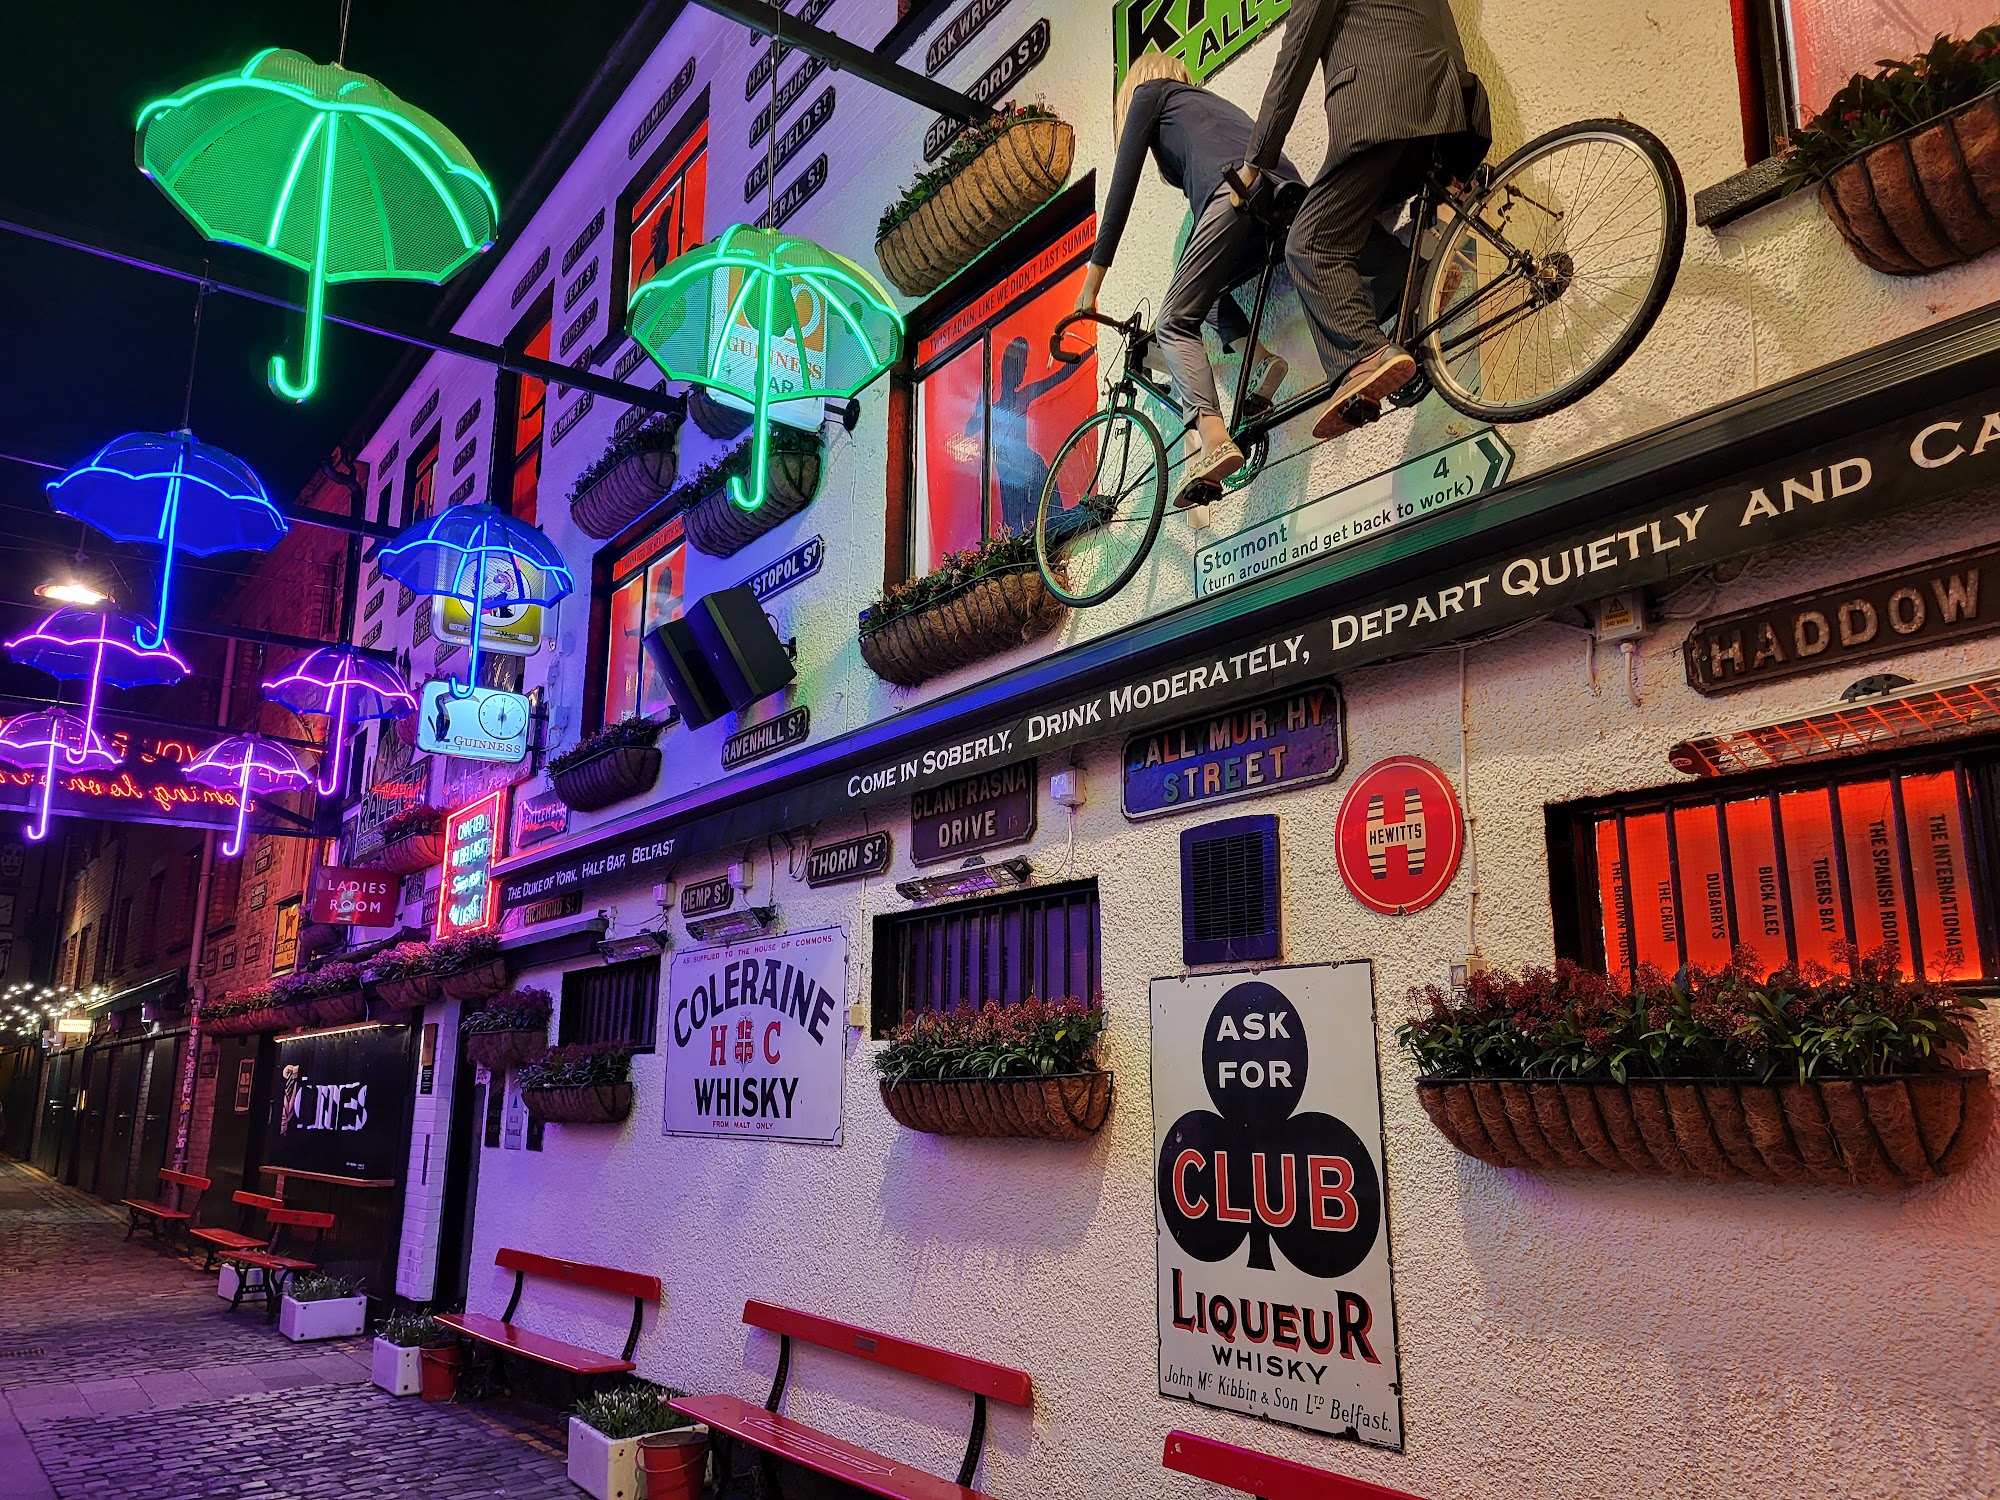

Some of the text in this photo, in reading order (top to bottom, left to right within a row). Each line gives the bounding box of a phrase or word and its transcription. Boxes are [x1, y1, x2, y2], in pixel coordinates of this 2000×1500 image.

[926, 56, 1013, 154] BRAFORD
[930, 220, 1096, 353] TWIST AGAIN, LIKE WE DIDN'T LAST SUMME
[728, 335, 822, 380] GUINESS
[1433, 457, 1450, 480] 4
[1202, 475, 1474, 596] (turn around and get back to work)
[1202, 522, 1288, 575] Stormont
[749, 559, 800, 596] STOPOL
[847, 766, 897, 798] COME
[900, 759, 919, 783] IN
[922, 729, 1013, 774] SOBERLY,
[1027, 699, 1102, 743] DRINK
[1109, 633, 1310, 718] MODERATELY,
[1330, 574, 1490, 652] DEPART
[1500, 506, 1710, 598] QUIETLY
[1738, 456, 1873, 529] AND
[1606, 610, 1629, 620] DANGER
[1709, 568, 1980, 679] HADDOW
[454, 735, 521, 754] GUINNESS
[722, 722, 784, 763] RAVENHILL
[1130, 690, 1325, 772] BALLYMURPHY
[913, 763, 1027, 821] CLANTRASNA
[1163, 745, 1287, 803] STREET
[938, 810, 996, 848] DRIVE
[1369, 823, 1422, 846] HEWITTS
[1869, 819, 1888, 847] THE
[1930, 813, 1949, 842] THE
[508, 886, 521, 902] THE
[523, 878, 542, 897] DUKE
[544, 875, 555, 892] OF
[582, 859, 606, 879] HALF
[631, 838, 676, 864] BELFAST
[812, 847, 857, 878] THORN
[1873, 848, 1895, 908] SPANISH
[328, 880, 386, 894] LADIES
[330, 900, 381, 913] ROOM
[682, 886, 711, 912] HEMP
[1706, 872, 1725, 940] DUBARRYS
[1758, 866, 1779, 936] BUCK ALEC
[1813, 857, 1836, 933] TIGERS BAY
[525, 901, 562, 925] RICHMOND
[1658, 880, 1675, 942] THE CRUM
[693, 952, 720, 963] SUPPLIED
[738, 948, 750, 956] THE
[754, 943, 776, 954] HOUSE
[781, 941, 791, 949] OF
[795, 934, 834, 947] COMMONS.
[674, 958, 835, 1048] COLERAINE
[710, 1021, 781, 1066] H C
[1216, 1011, 1291, 1042] ASK
[1217, 1060, 1293, 1089] FOR
[694, 1077, 799, 1119] WHISKY
[712, 1120, 729, 1128] FROM
[734, 1121, 750, 1129] MALT
[1172, 1149, 1359, 1233] CLUB
[1171, 1268, 1382, 1365] LIQUEUR
[1212, 1344, 1328, 1386] WHISKY
[1164, 1365, 1194, 1388] John
[1218, 1375, 1257, 1402] Kibbin
[1260, 1392, 1270, 1405] &
[1274, 1388, 1298, 1412] Son
[1330, 1399, 1392, 1432] Belfast.
